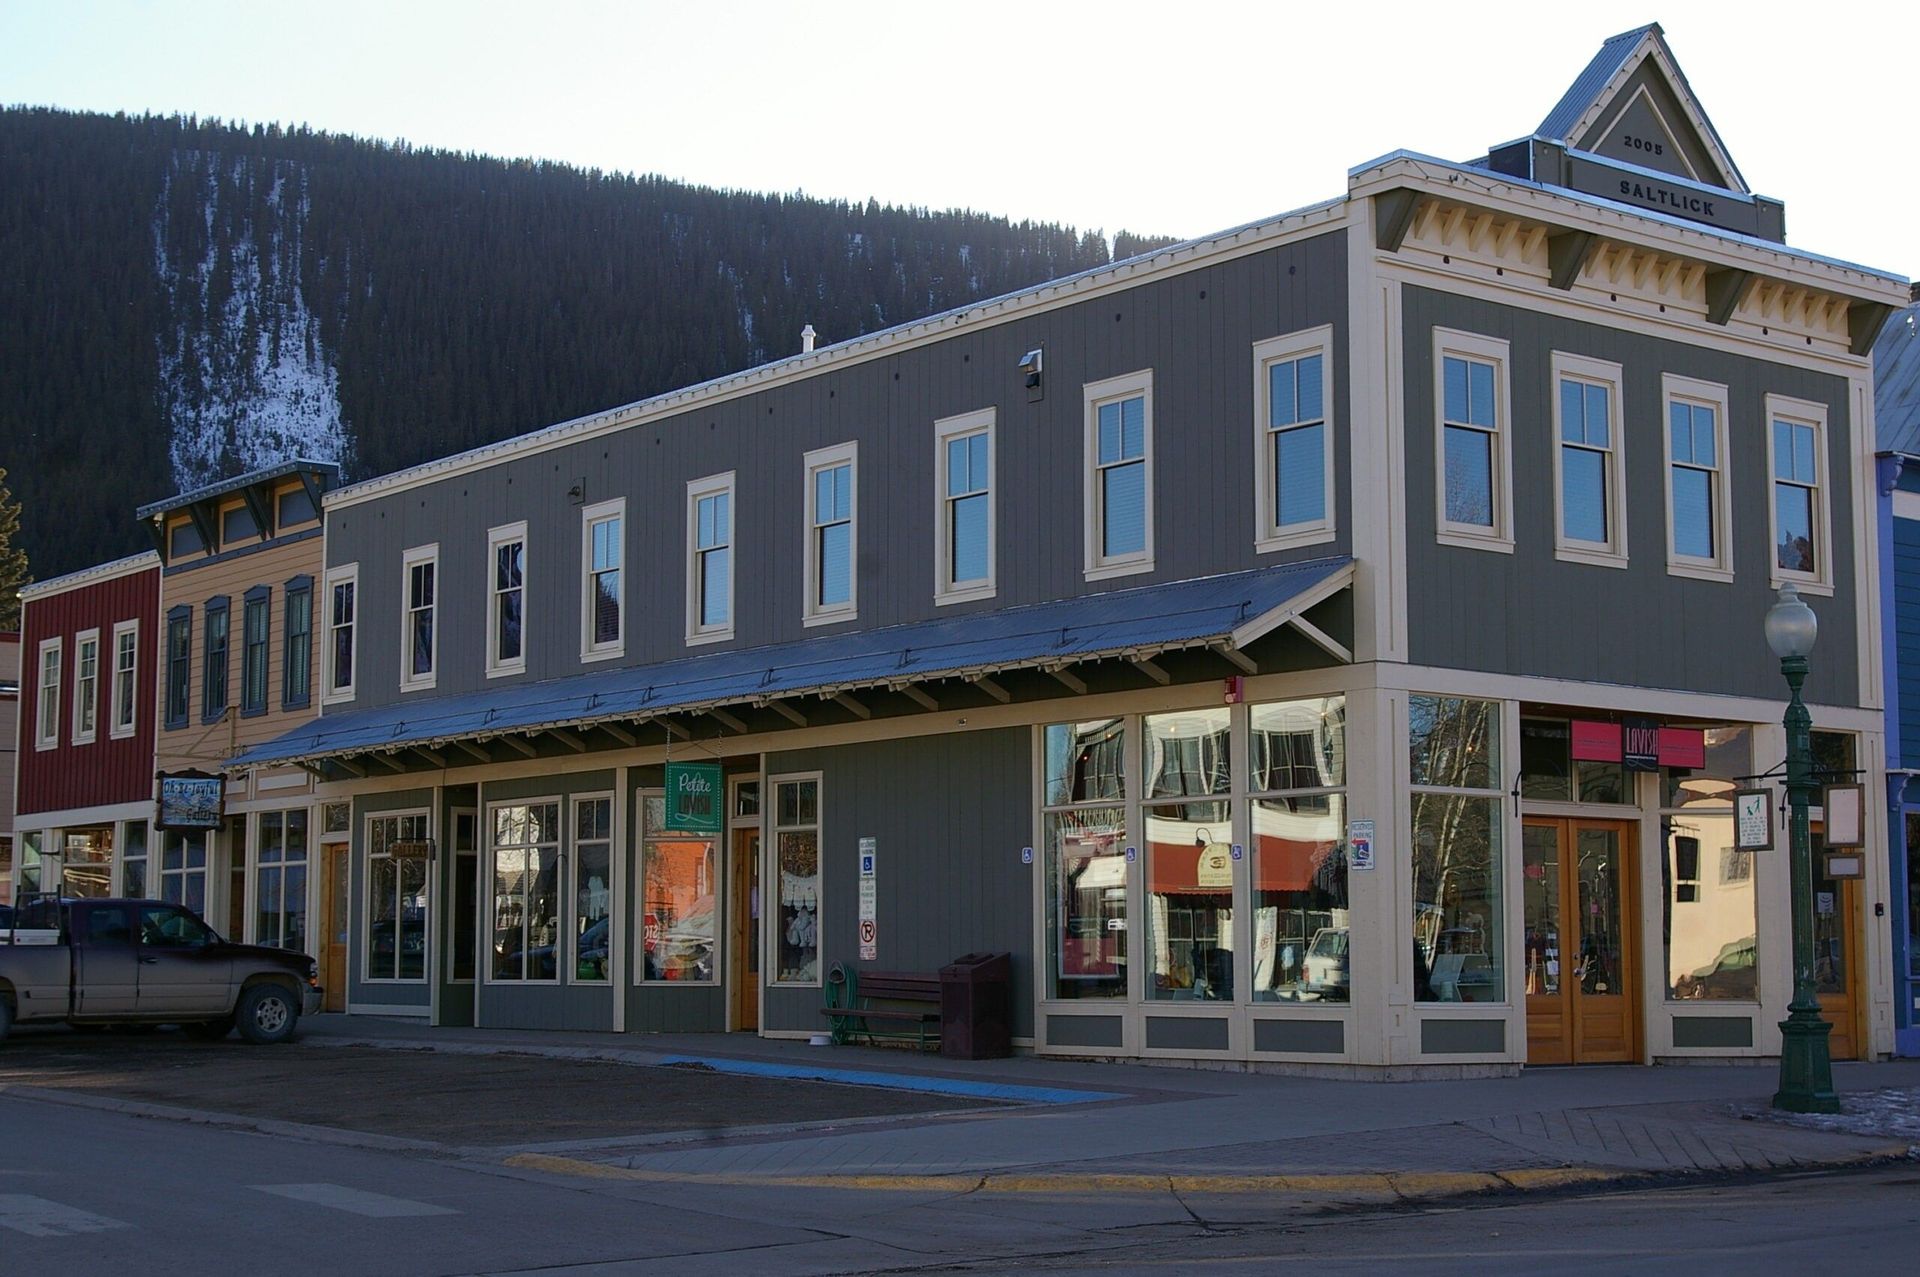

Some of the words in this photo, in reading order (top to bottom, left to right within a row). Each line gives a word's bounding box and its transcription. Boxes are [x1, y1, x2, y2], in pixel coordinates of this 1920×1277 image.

[1624, 135, 1663, 155] 2005
[1620, 180, 1714, 217] SALTLICK
[1626, 727, 1658, 755] LAVISH
[679, 772, 711, 792] Petite
